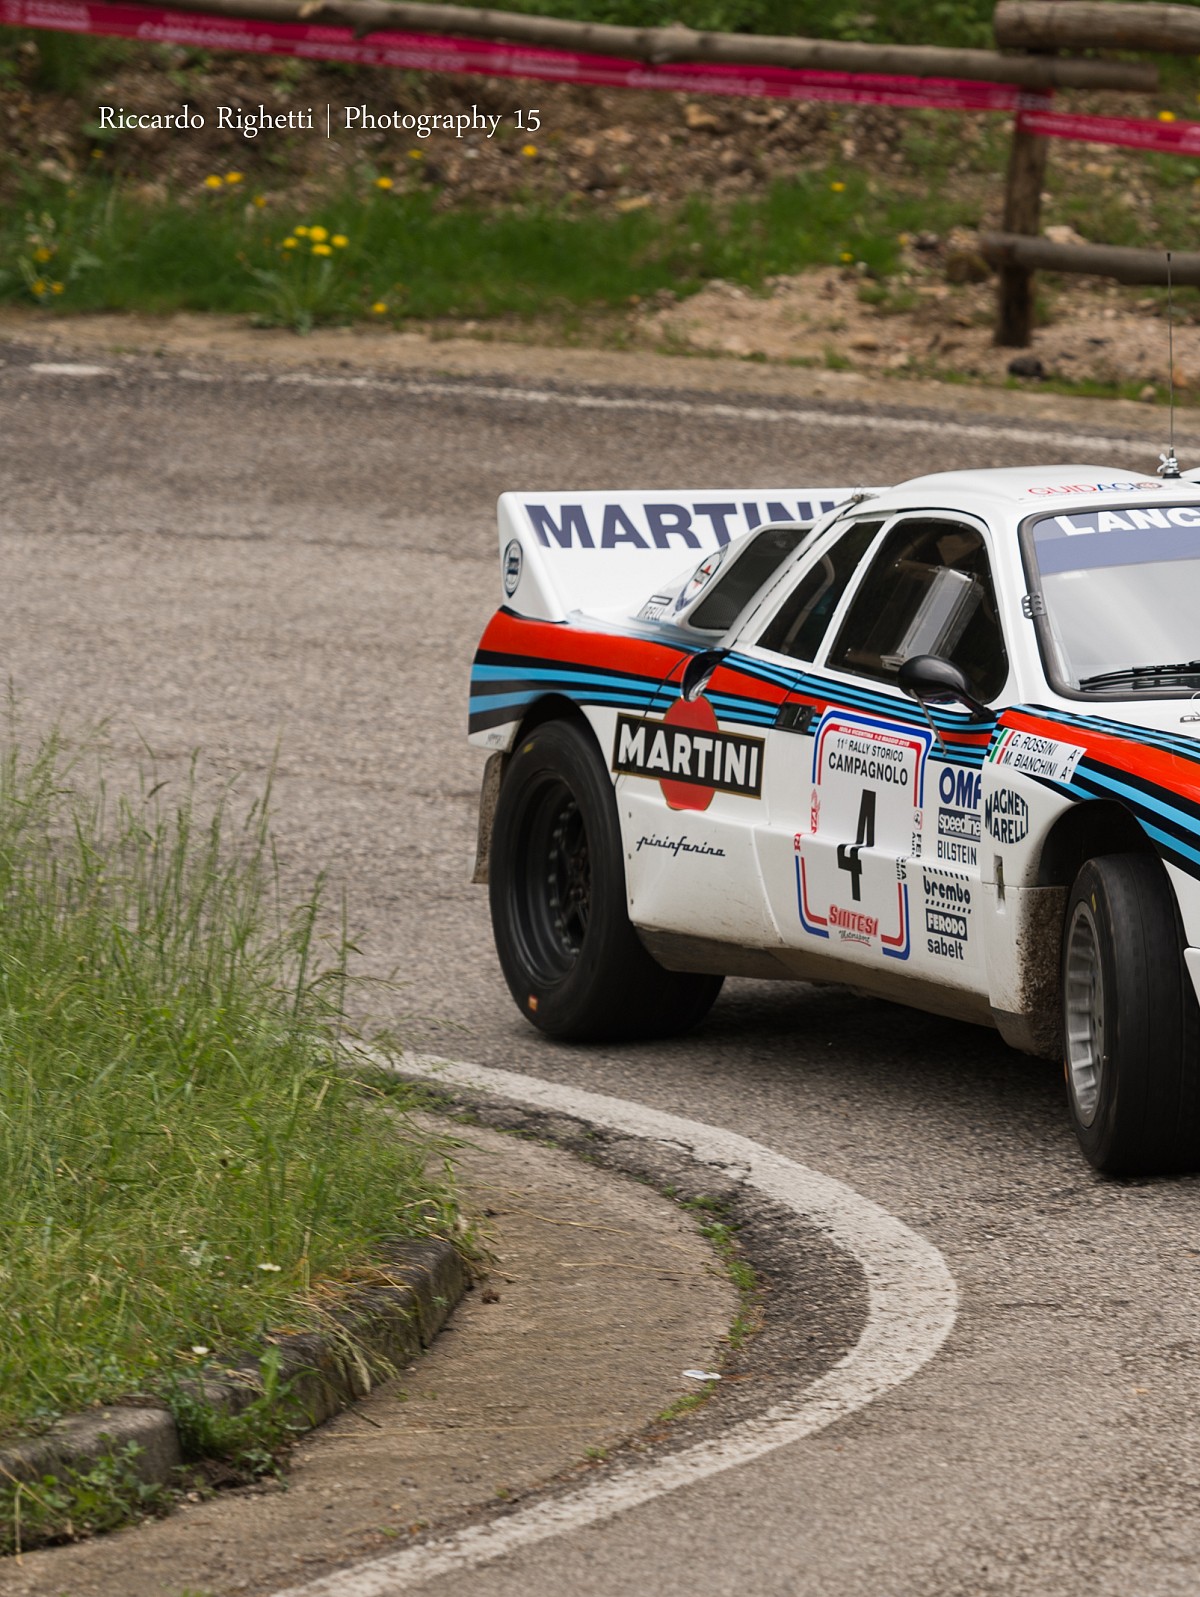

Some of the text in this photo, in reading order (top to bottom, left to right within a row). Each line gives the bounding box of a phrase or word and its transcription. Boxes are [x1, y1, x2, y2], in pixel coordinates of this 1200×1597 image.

[525, 501, 835, 549] MARTI
[617, 723, 759, 788] MARTINI
[849, 740, 870, 754] RALLY
[871, 744, 904, 763] STORICO
[1011, 734, 1020, 747] G.
[1021, 736, 1058, 757] ROSSINI
[828, 752, 908, 786] CAMPAGNOLO
[1003, 751, 1012, 765] M.
[1014, 754, 1058, 776] BIANCHINI
[985, 788, 1029, 826] MAGNETI
[938, 813, 981, 837] speedline
[985, 808, 1029, 844] MARELLI
[636, 834, 726, 857] pininfarina
[836, 788, 877, 902] 4
[937, 840, 977, 866] BILSTEIN
[923, 876, 971, 905] brembo
[927, 911, 967, 939] FERODO
[927, 937, 964, 961] sabelt
